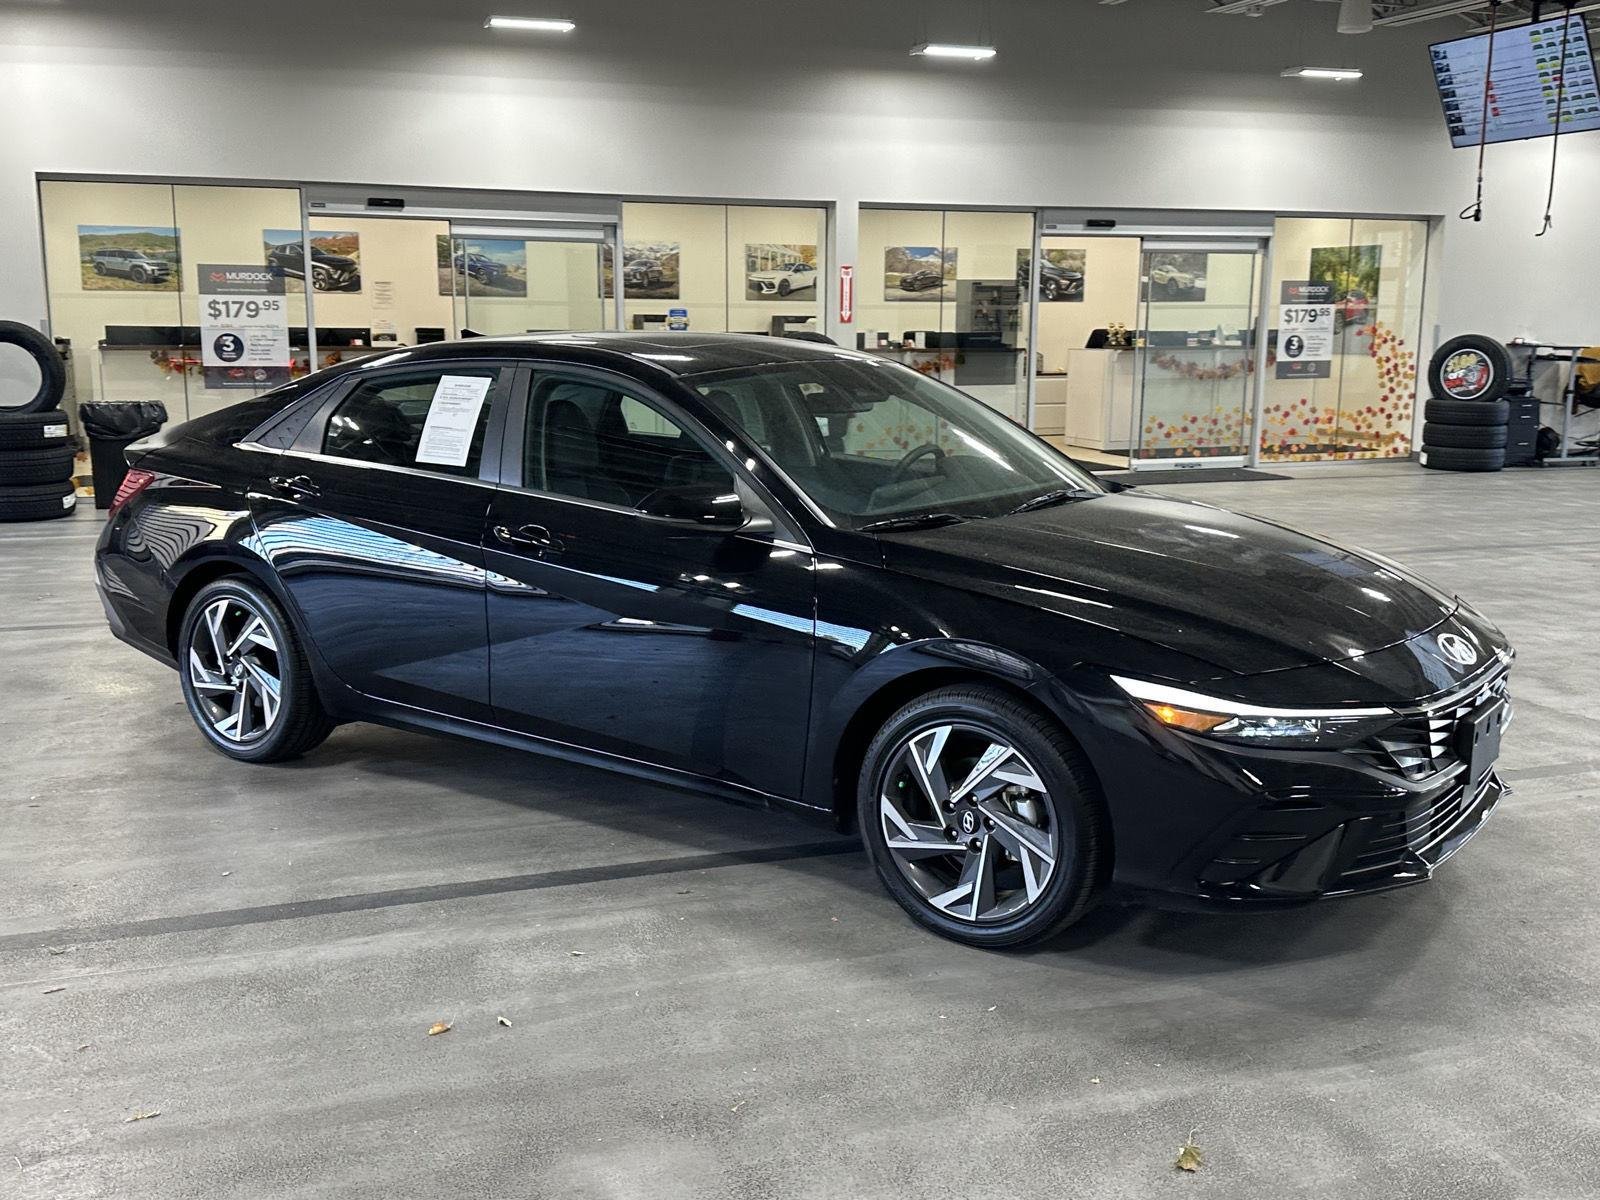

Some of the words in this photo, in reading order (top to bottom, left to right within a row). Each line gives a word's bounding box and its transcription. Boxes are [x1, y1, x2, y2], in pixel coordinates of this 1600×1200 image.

[225, 272, 273, 281] MURDOCK
[208, 299, 280, 320] $179.95
[1284, 307, 1331, 325] $179.95
[222, 335, 235, 352] 3
[1289, 337, 1300, 350] 3
